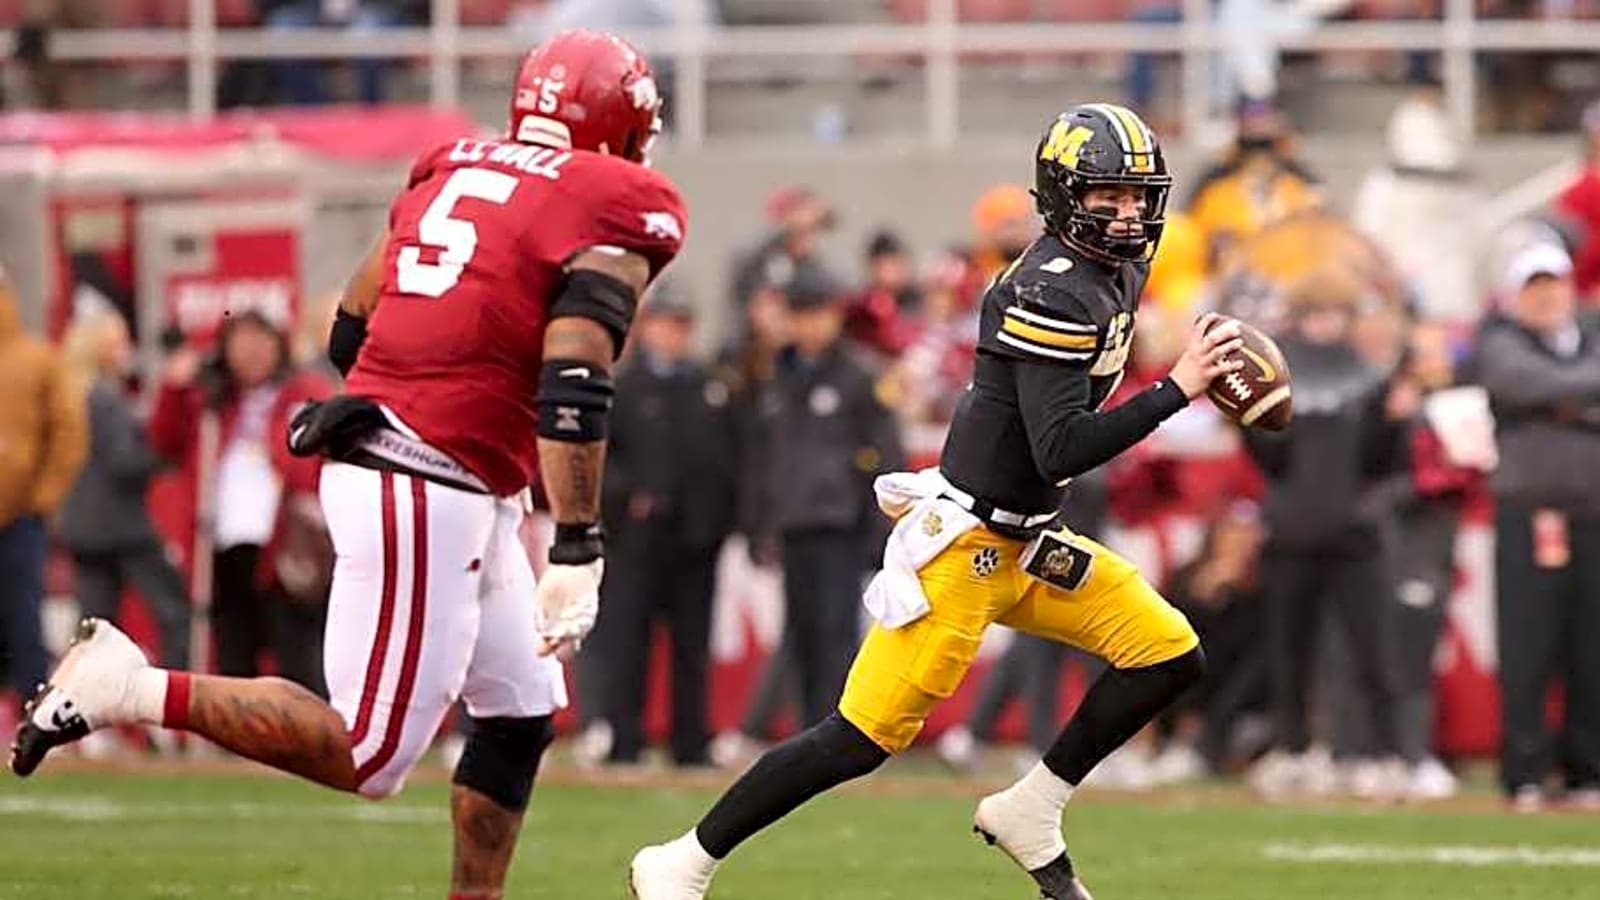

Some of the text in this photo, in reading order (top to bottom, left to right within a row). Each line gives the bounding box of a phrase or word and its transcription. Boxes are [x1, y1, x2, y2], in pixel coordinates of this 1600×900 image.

[538, 77, 566, 114] 5
[1040, 116, 1095, 171] M
[396, 167, 521, 298] 5
